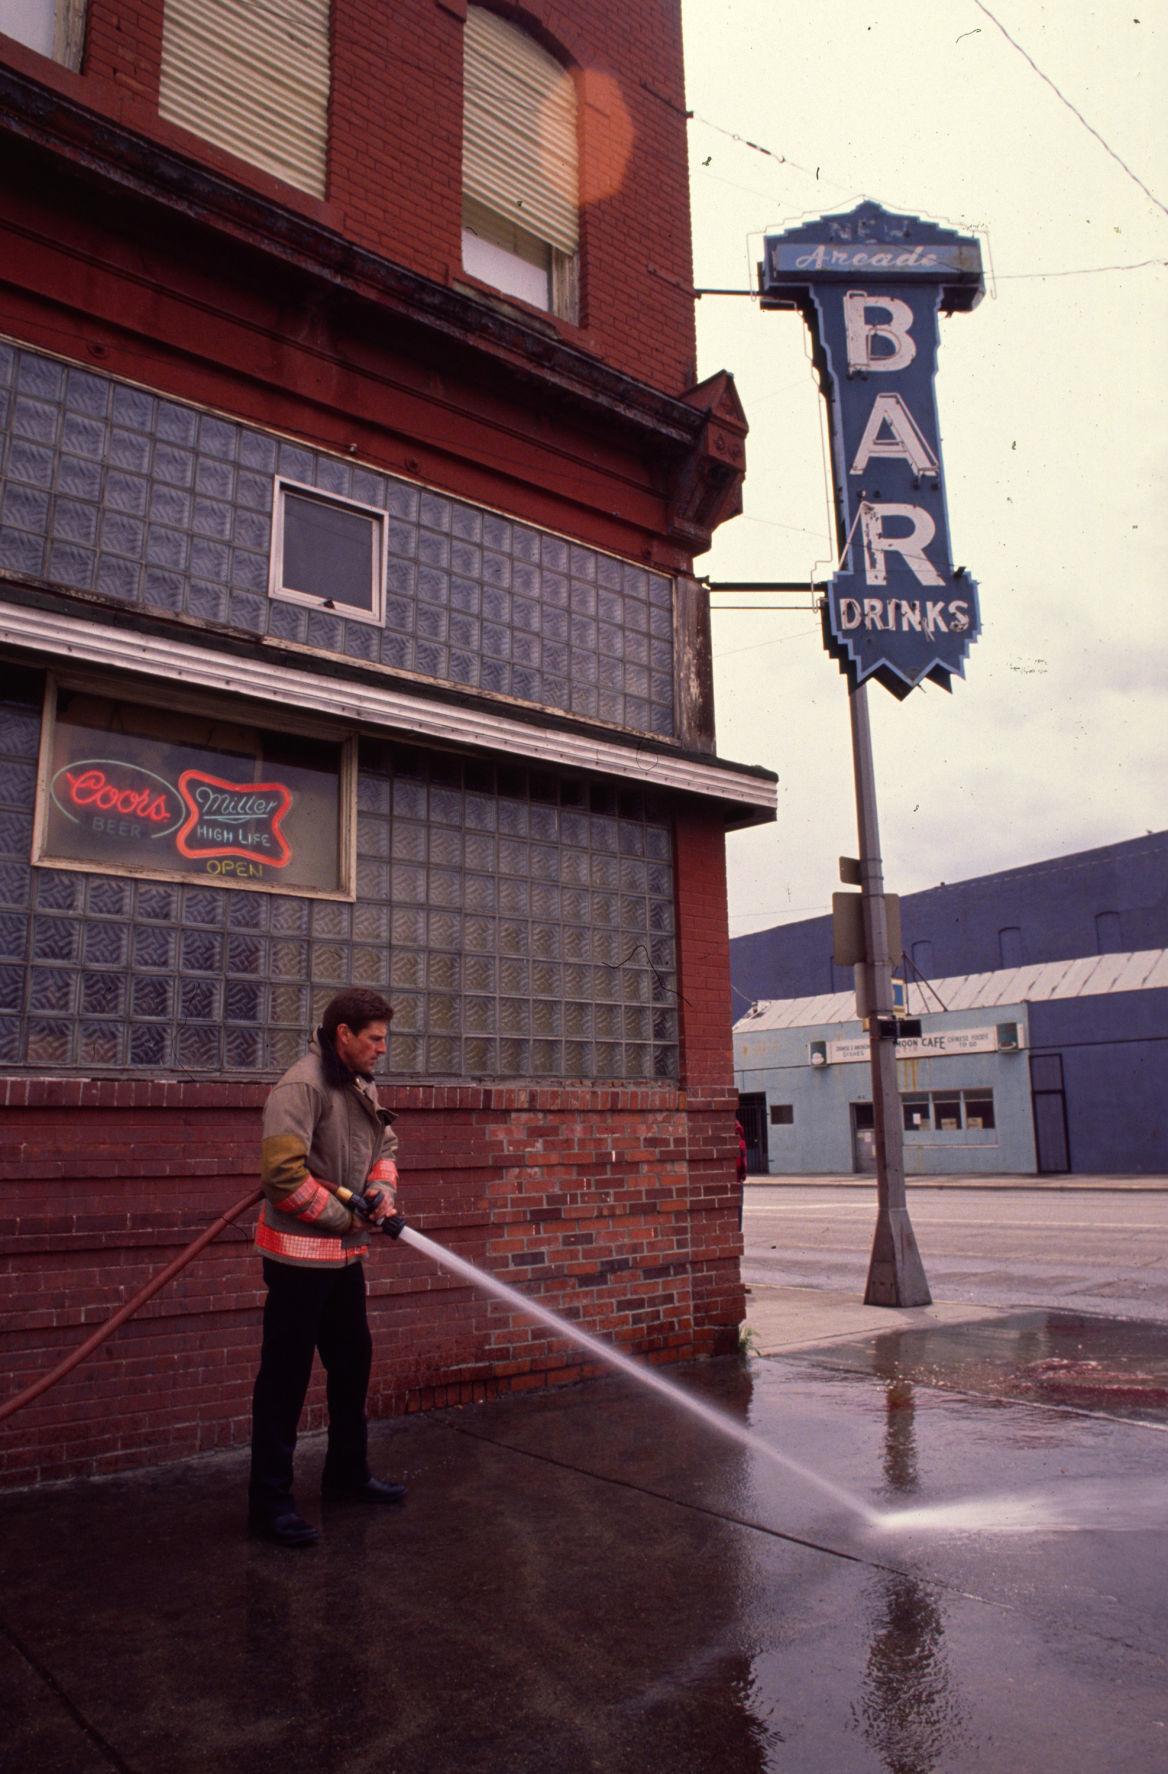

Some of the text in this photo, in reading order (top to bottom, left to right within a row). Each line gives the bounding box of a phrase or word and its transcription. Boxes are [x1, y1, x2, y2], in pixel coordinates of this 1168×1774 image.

[796, 245, 938, 268] Arcade
[843, 291, 946, 586] BAR
[839, 598, 970, 633] DRINKS
[196, 787, 278, 815] Miller
[92, 818, 141, 838] BEER
[197, 823, 271, 847] HIGH LIFE
[206, 860, 263, 878] OPEN
[921, 1036, 945, 1050] CAFE
